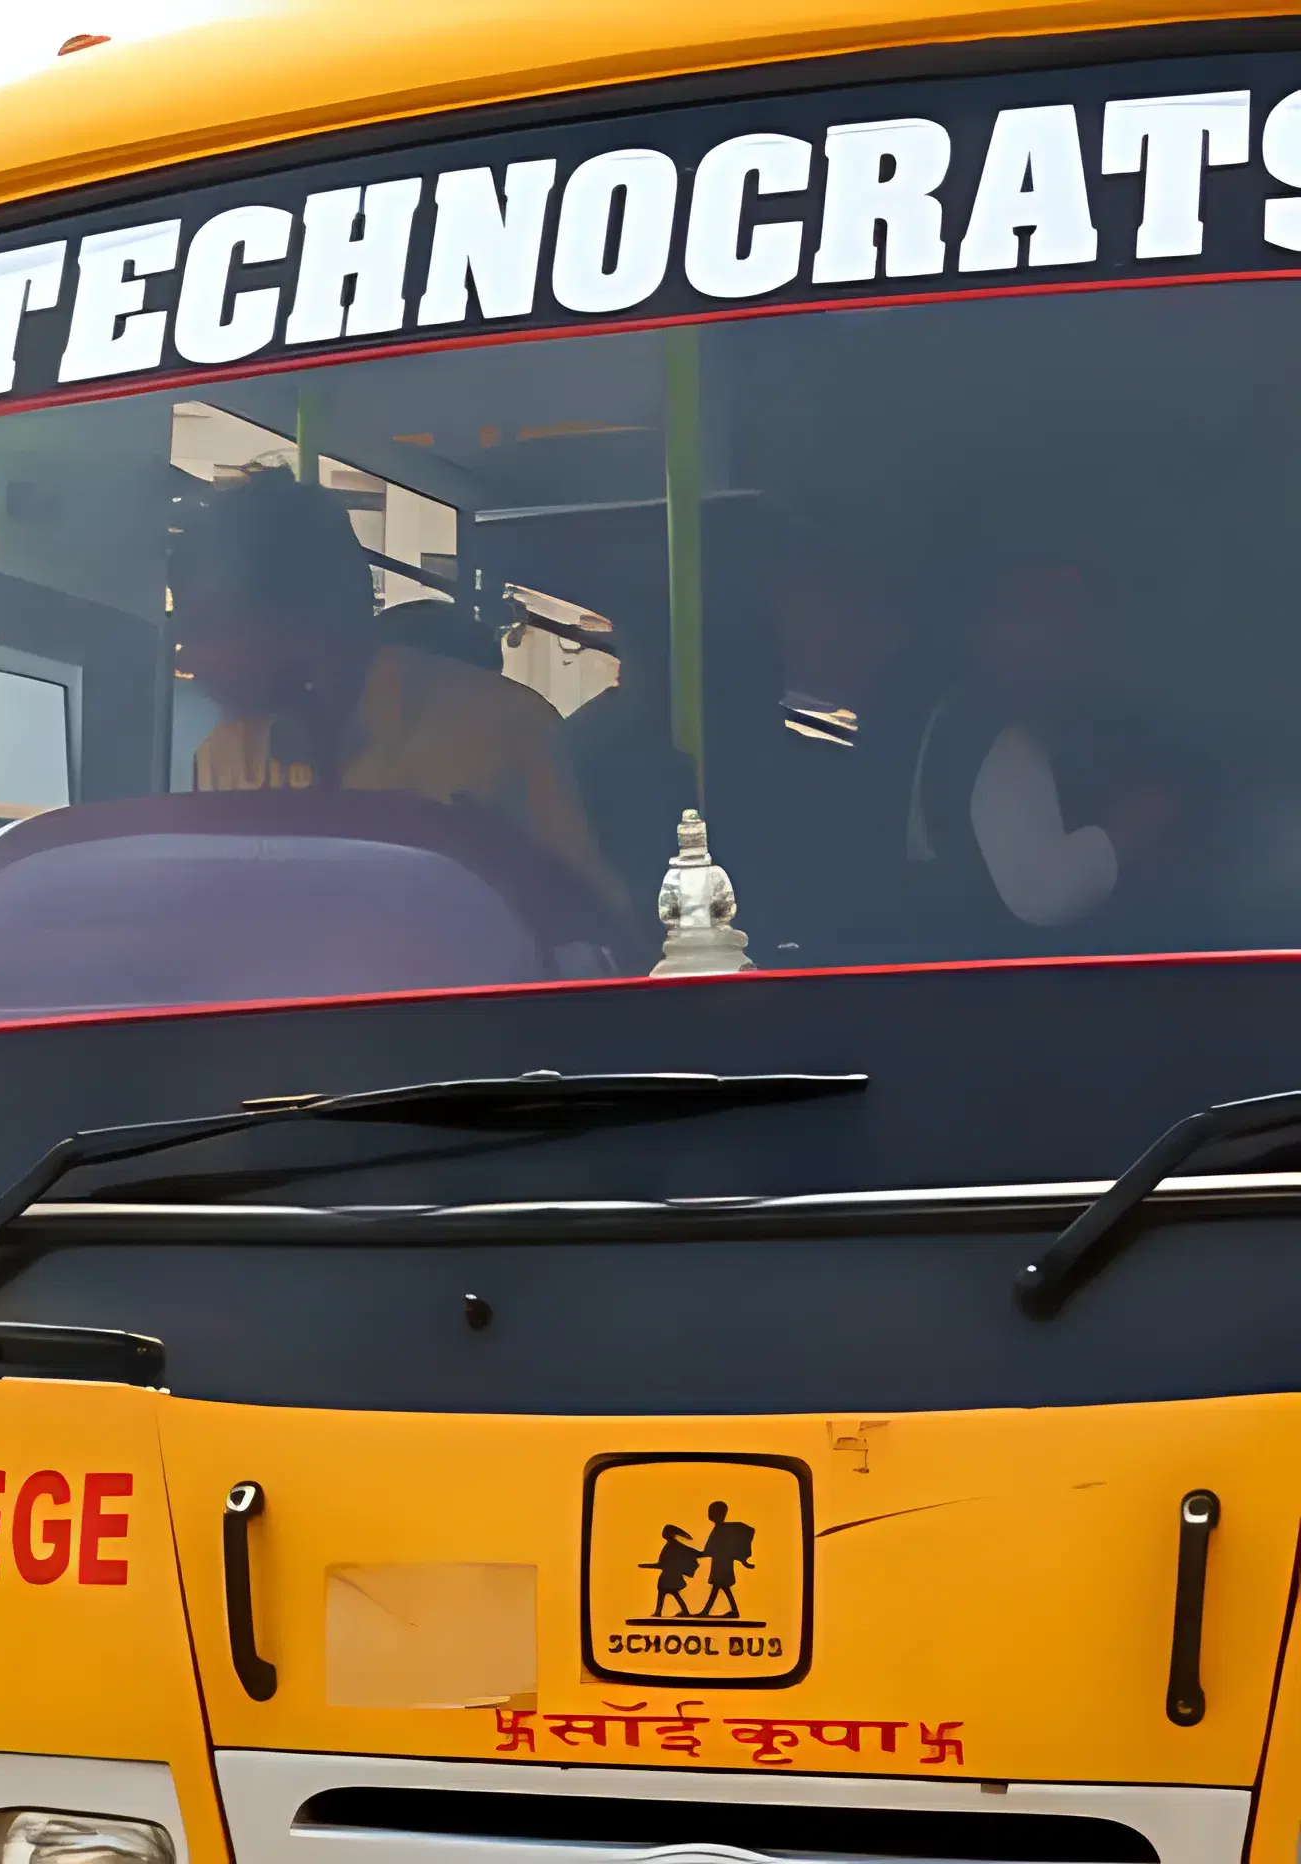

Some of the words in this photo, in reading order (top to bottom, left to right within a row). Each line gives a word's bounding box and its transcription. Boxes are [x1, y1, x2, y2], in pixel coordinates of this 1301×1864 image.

[608, 1634, 720, 1656] SCHOOL
[728, 1636, 783, 1658] BUS
[722, 1718, 909, 1765] कृपा
